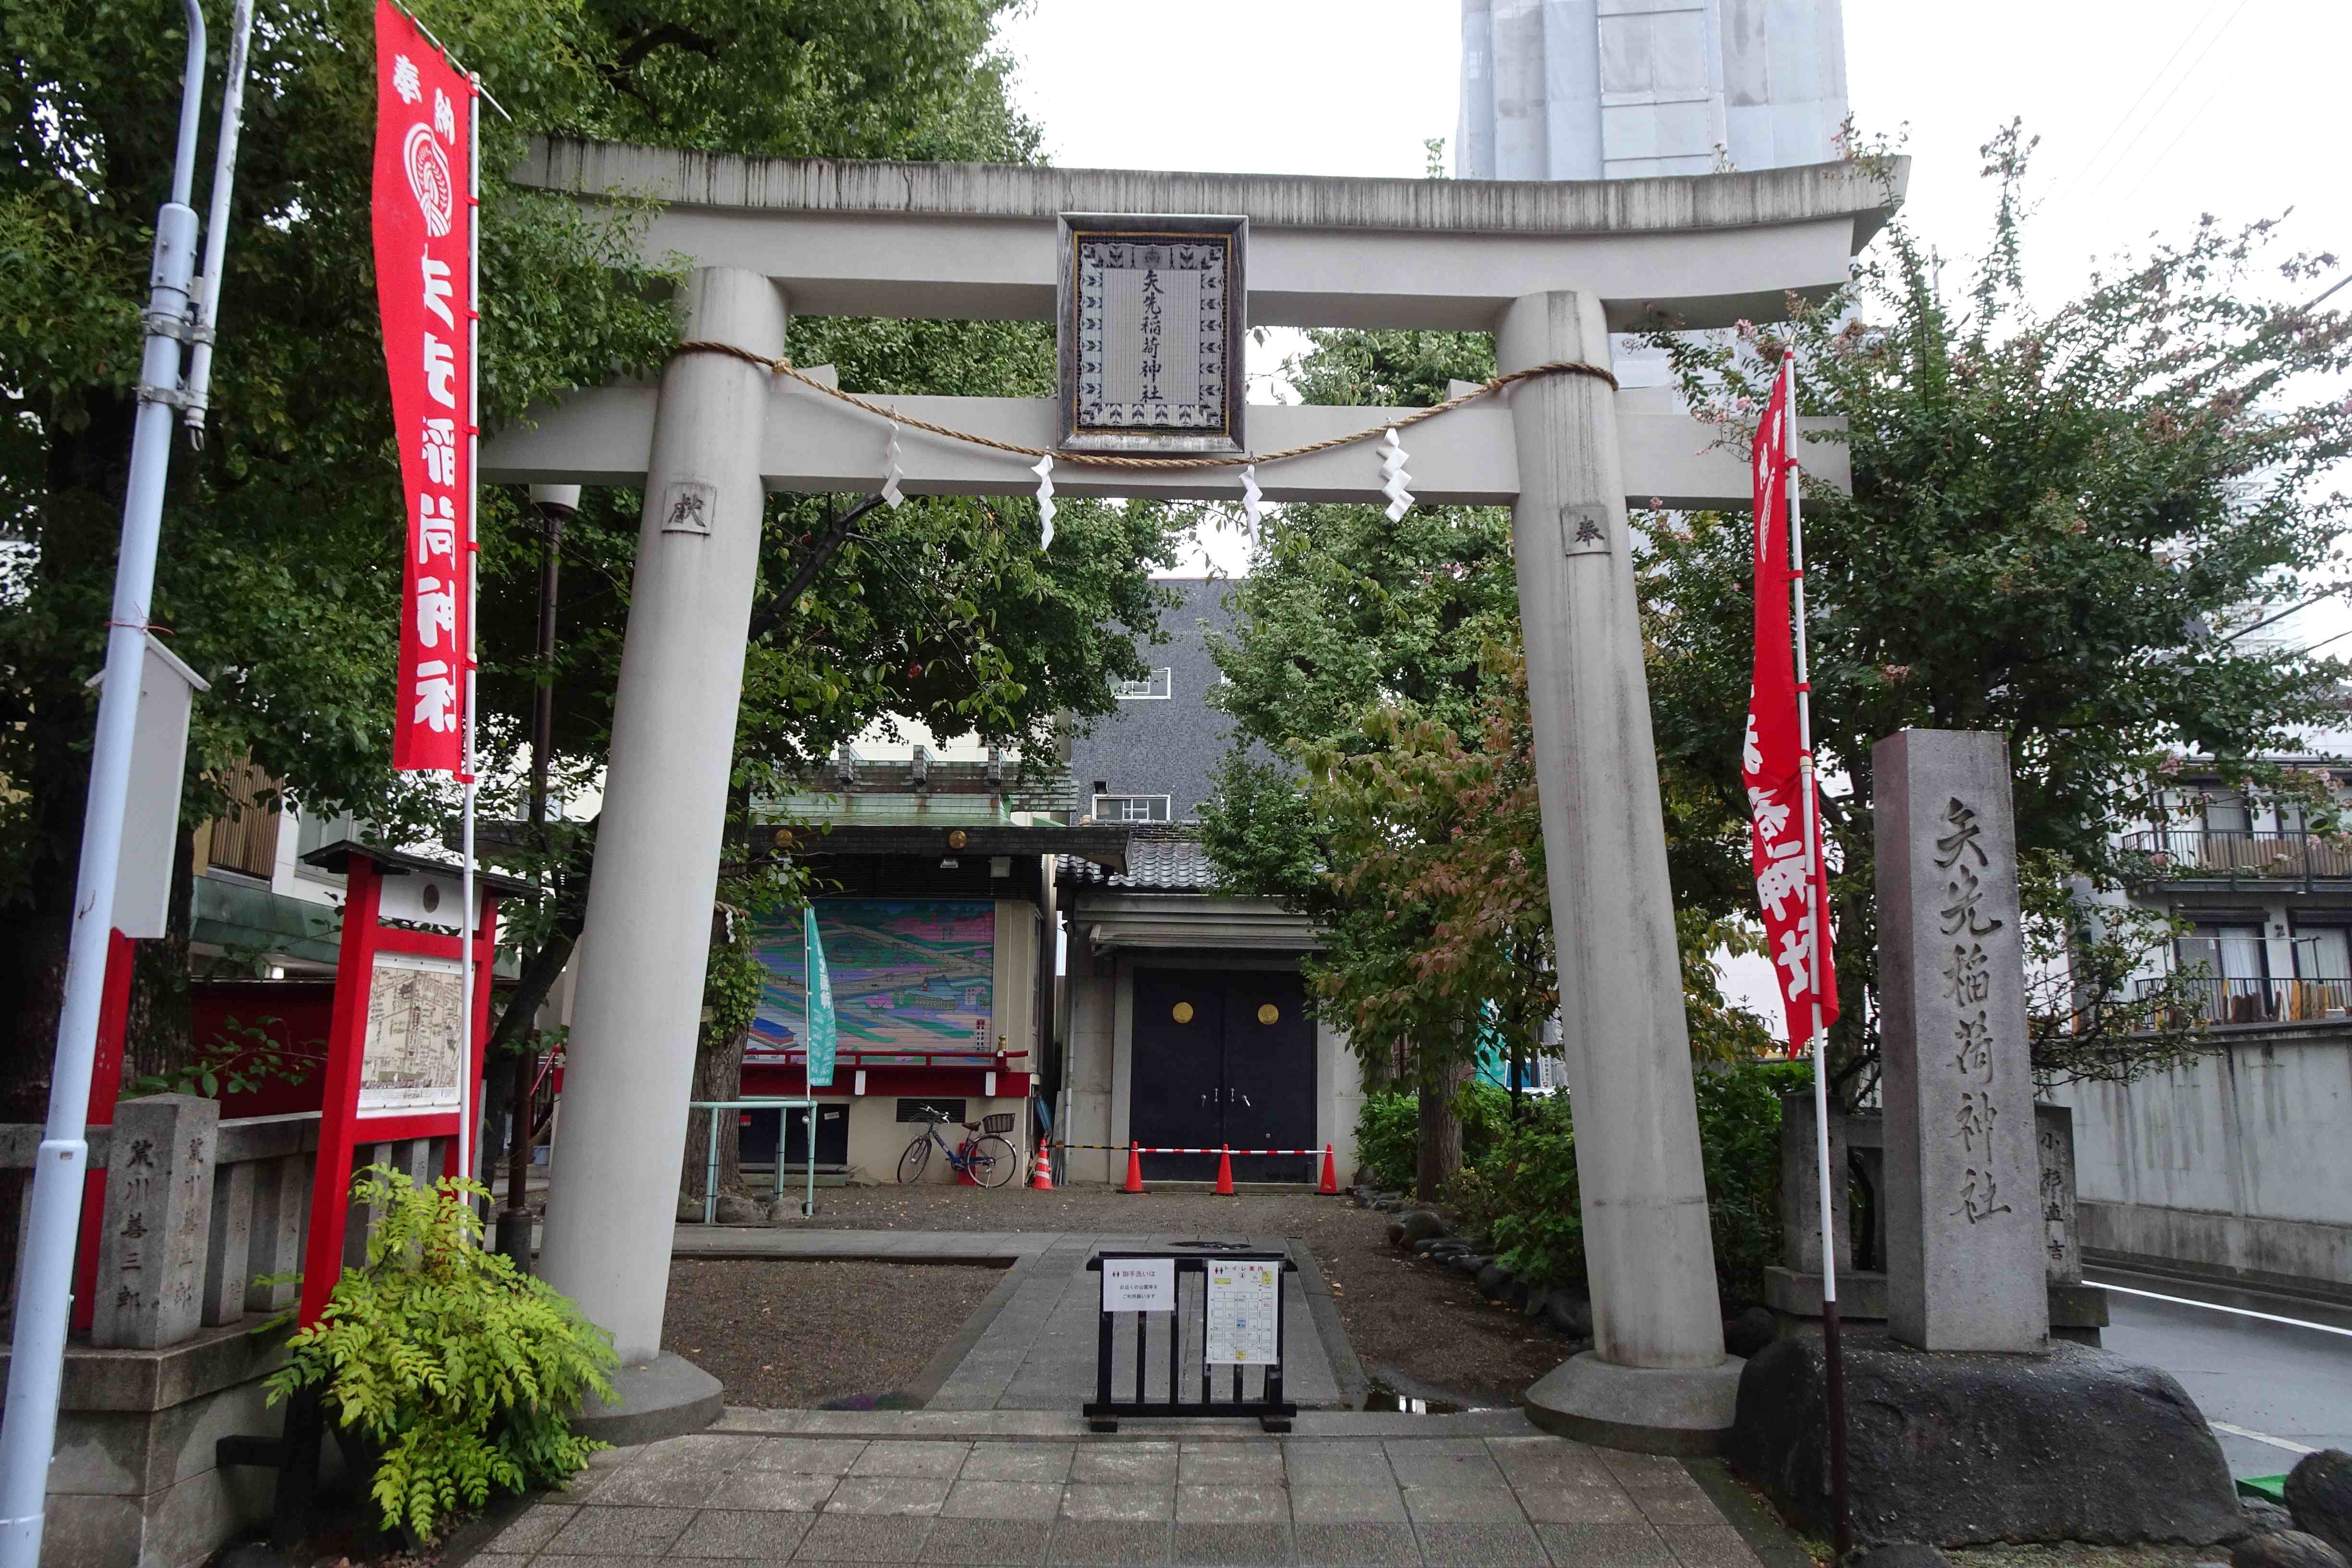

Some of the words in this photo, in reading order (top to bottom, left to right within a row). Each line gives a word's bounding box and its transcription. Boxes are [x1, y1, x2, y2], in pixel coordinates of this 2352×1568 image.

[1139, 270, 1164, 402] 矢先稲荷神社
[1575, 514, 1605, 547] 奉
[1933, 796, 2012, 1225] 矢先稲荷神社
[115, 1139, 154, 1309] 荒川善三郎
